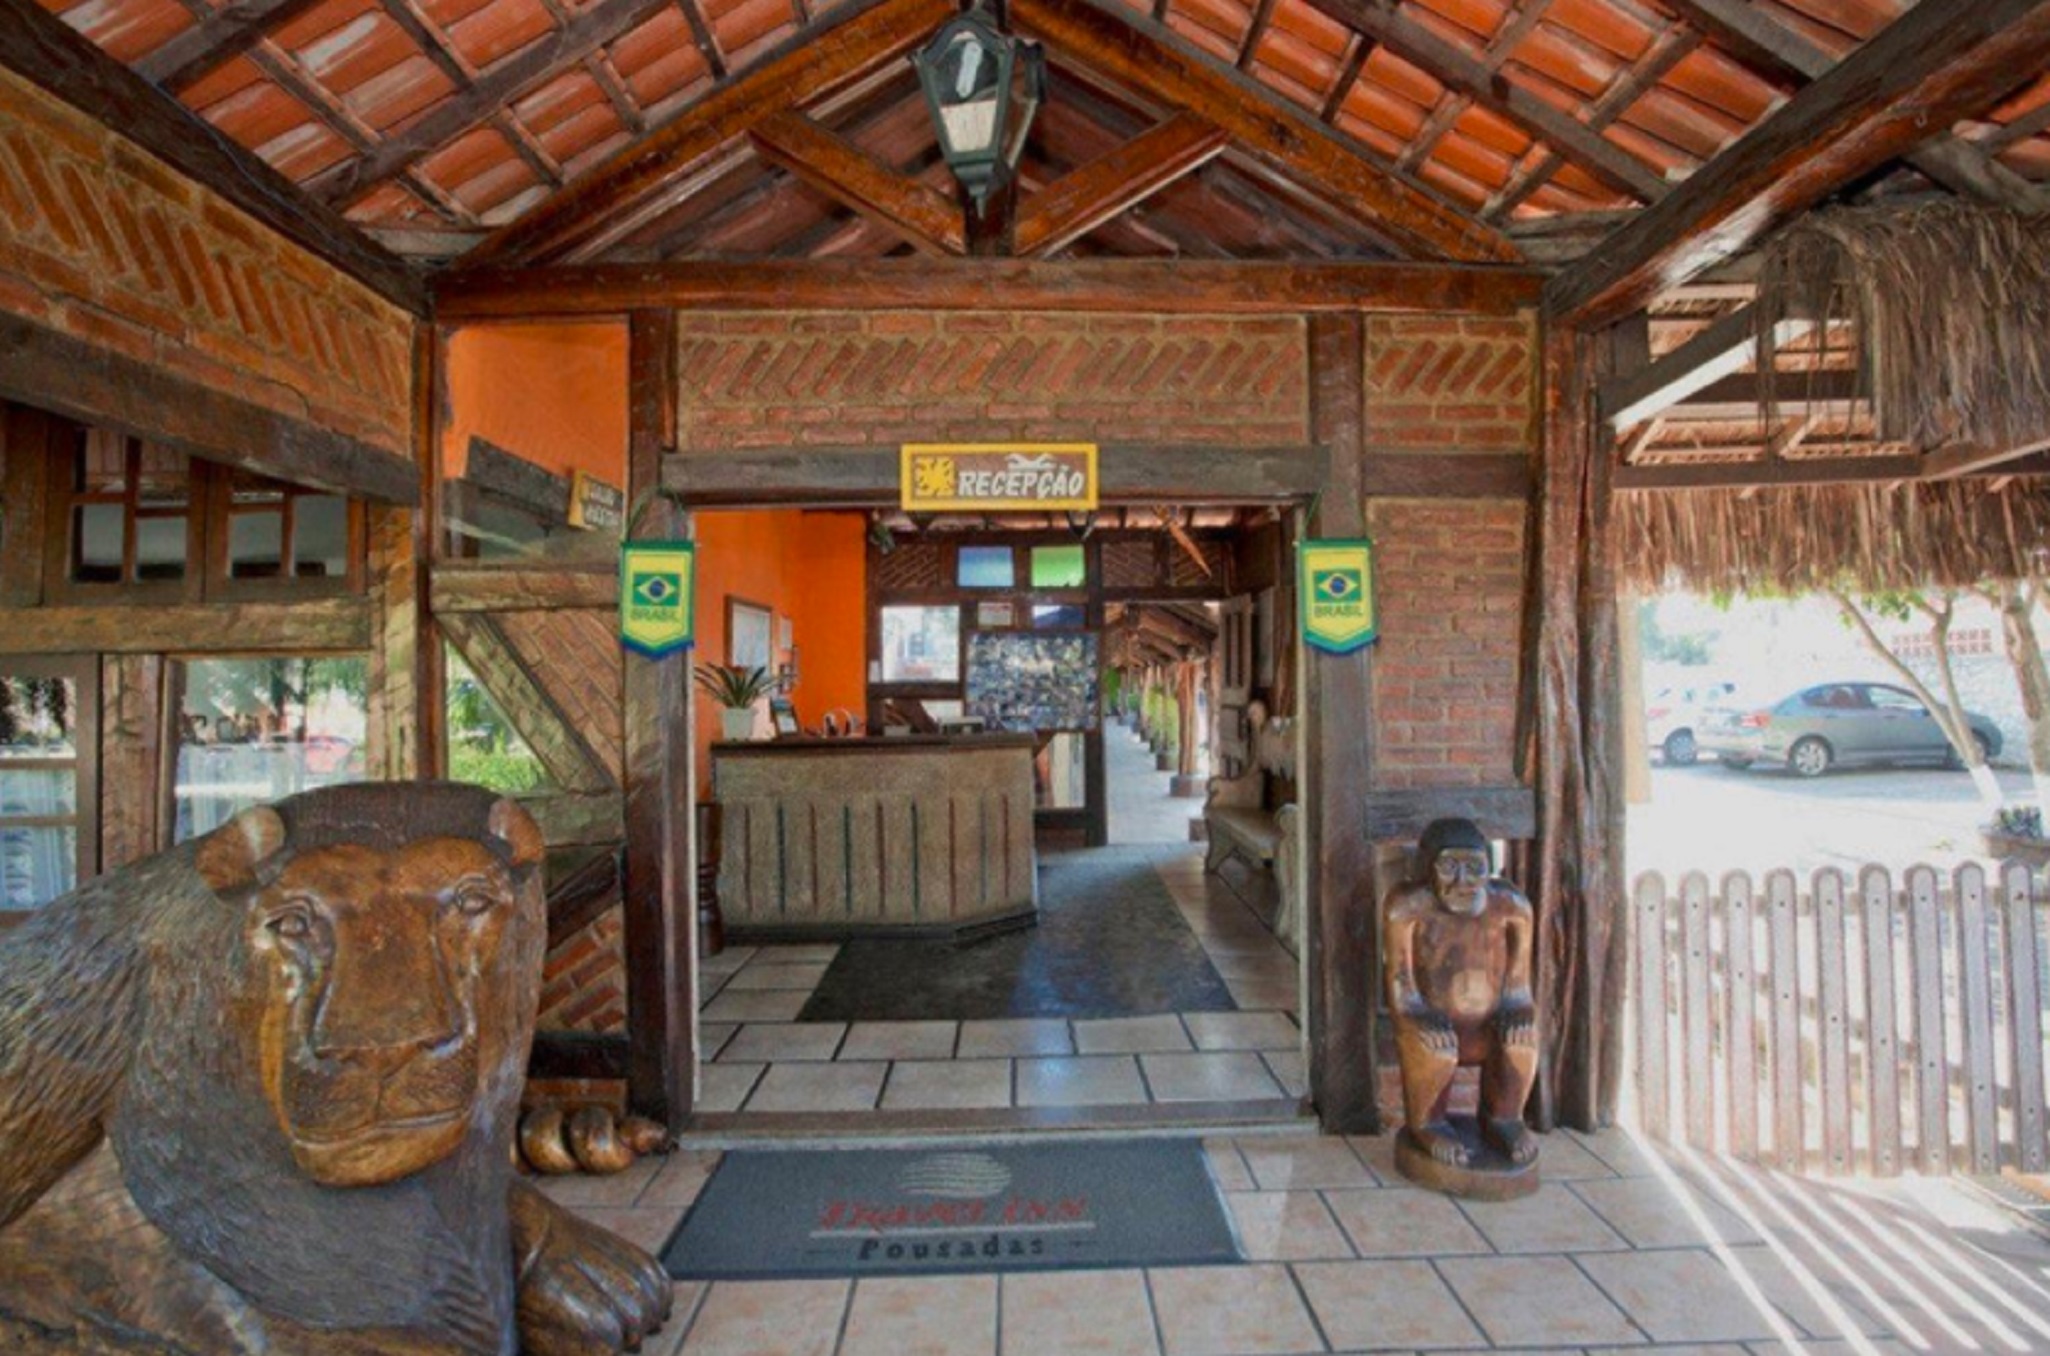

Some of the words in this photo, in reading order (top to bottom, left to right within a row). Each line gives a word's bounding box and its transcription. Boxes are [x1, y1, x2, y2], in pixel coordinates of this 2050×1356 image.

[958, 465, 1084, 499] RECEPÇÃO
[630, 606, 680, 621] BRASIL
[1314, 605, 1363, 618] BRASIL
[858, 1233, 1043, 1261] Pousadas
